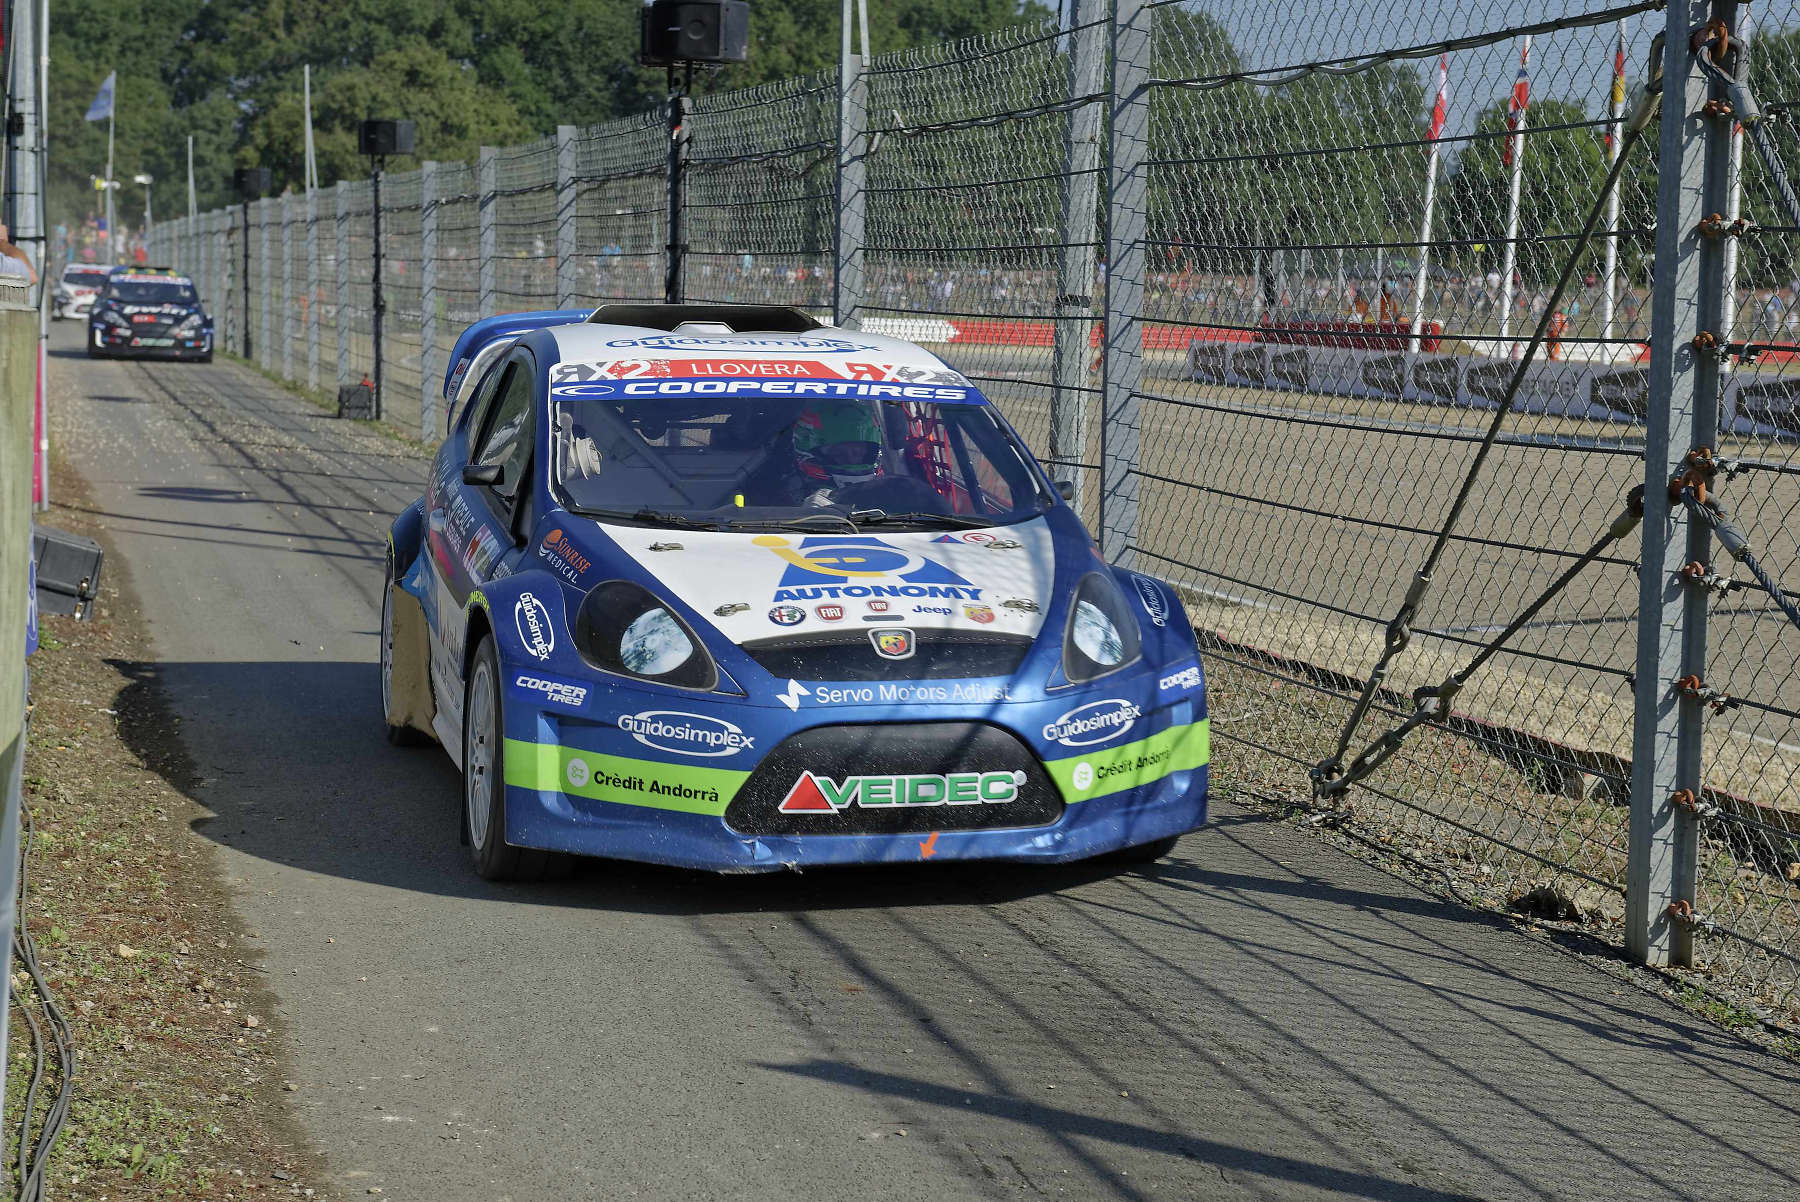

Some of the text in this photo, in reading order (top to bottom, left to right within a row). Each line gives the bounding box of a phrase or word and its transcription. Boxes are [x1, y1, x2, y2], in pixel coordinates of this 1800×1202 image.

[691, 363, 811, 377] LLOVERA
[546, 552, 578, 584] MEDICAL
[773, 585, 984, 602] AUTONOMY
[819, 606, 843, 619] FIAT
[912, 604, 953, 616] Jeep
[518, 592, 550, 662] Guidosimplex
[515, 675, 588, 698] COOPER
[1159, 667, 1200, 690] COOPER
[546, 692, 585, 706] TIRES
[815, 686, 874, 704] Servo
[952, 682, 1012, 702] Adjust
[617, 713, 756, 749] Guidosimplex
[1042, 704, 1142, 741] Guidosimplex
[593, 770, 720, 802] Crèdit Andorrà
[818, 771, 1016, 806] VEIDEC
